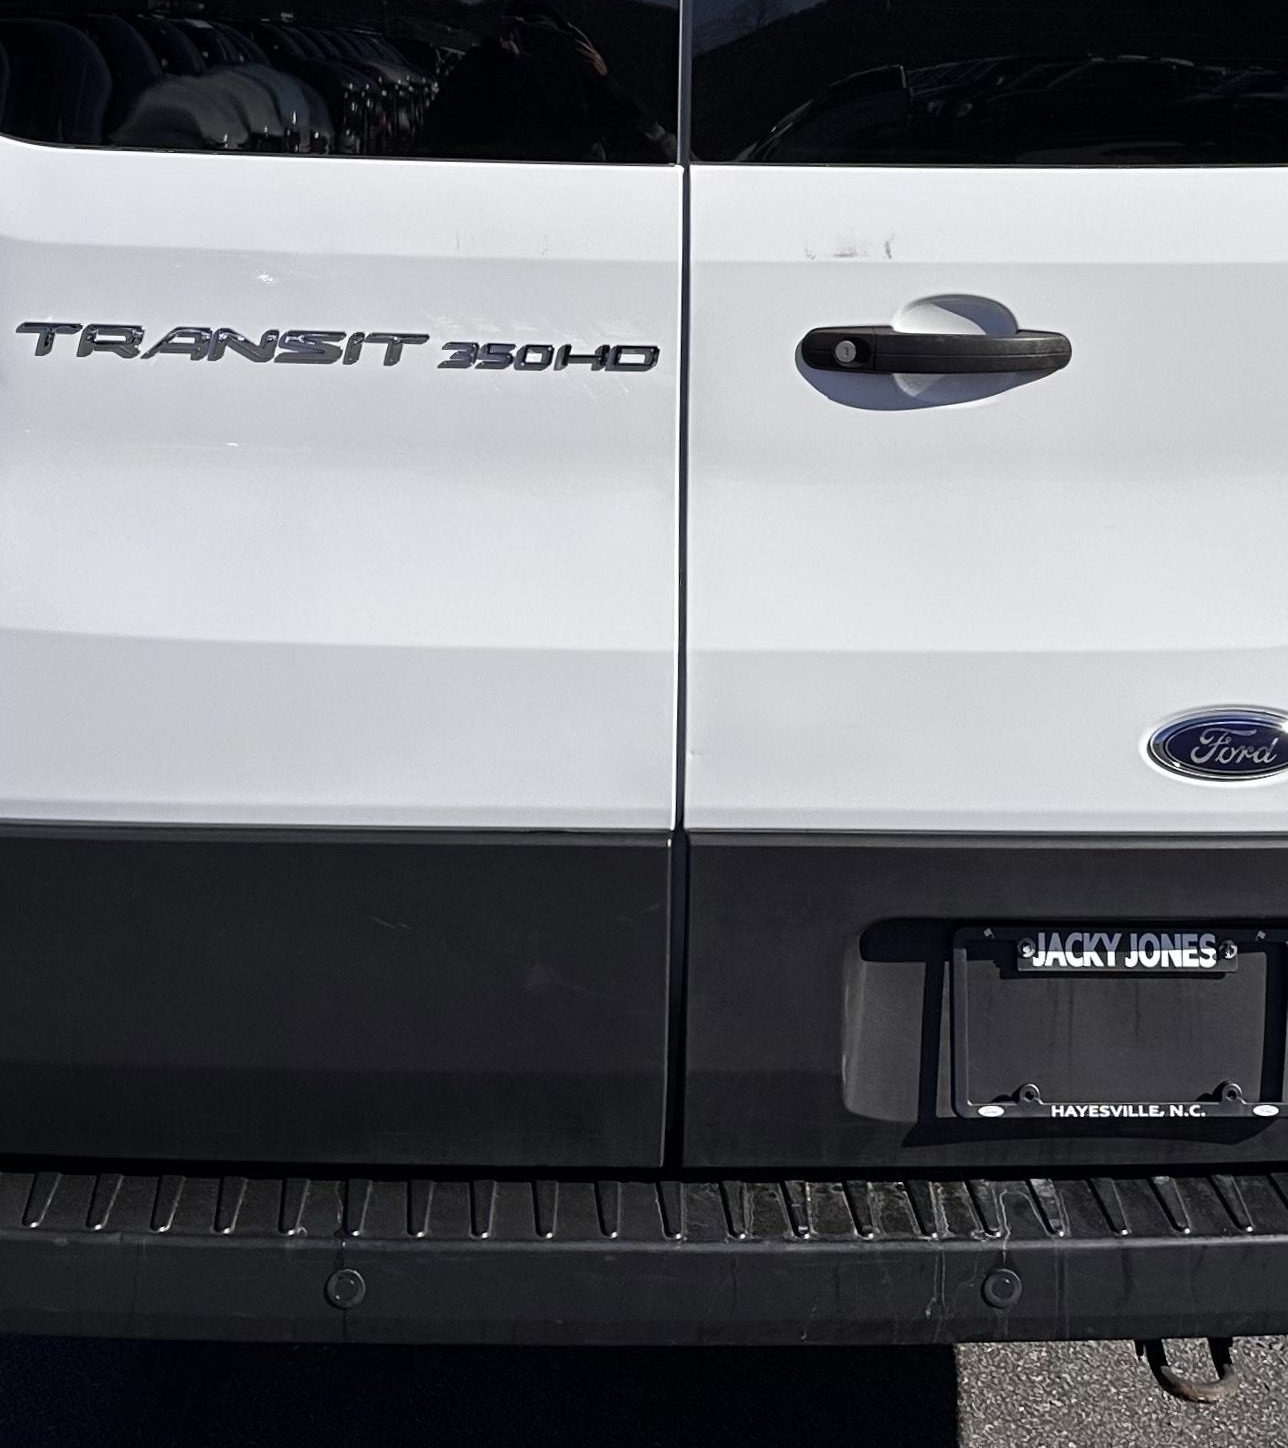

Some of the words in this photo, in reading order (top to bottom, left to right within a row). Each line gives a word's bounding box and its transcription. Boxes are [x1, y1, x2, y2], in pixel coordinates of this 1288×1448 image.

[16, 321, 430, 367] TRANSIT
[437, 341, 660, 373] 350HD
[1190, 727, 1280, 764] Ford
[1032, 931, 1122, 968] JACKY
[1124, 932, 1217, 969] JONES
[1050, 1104, 1165, 1119] HAYESVILLE,
[1170, 1104, 1207, 1118] N.C.
